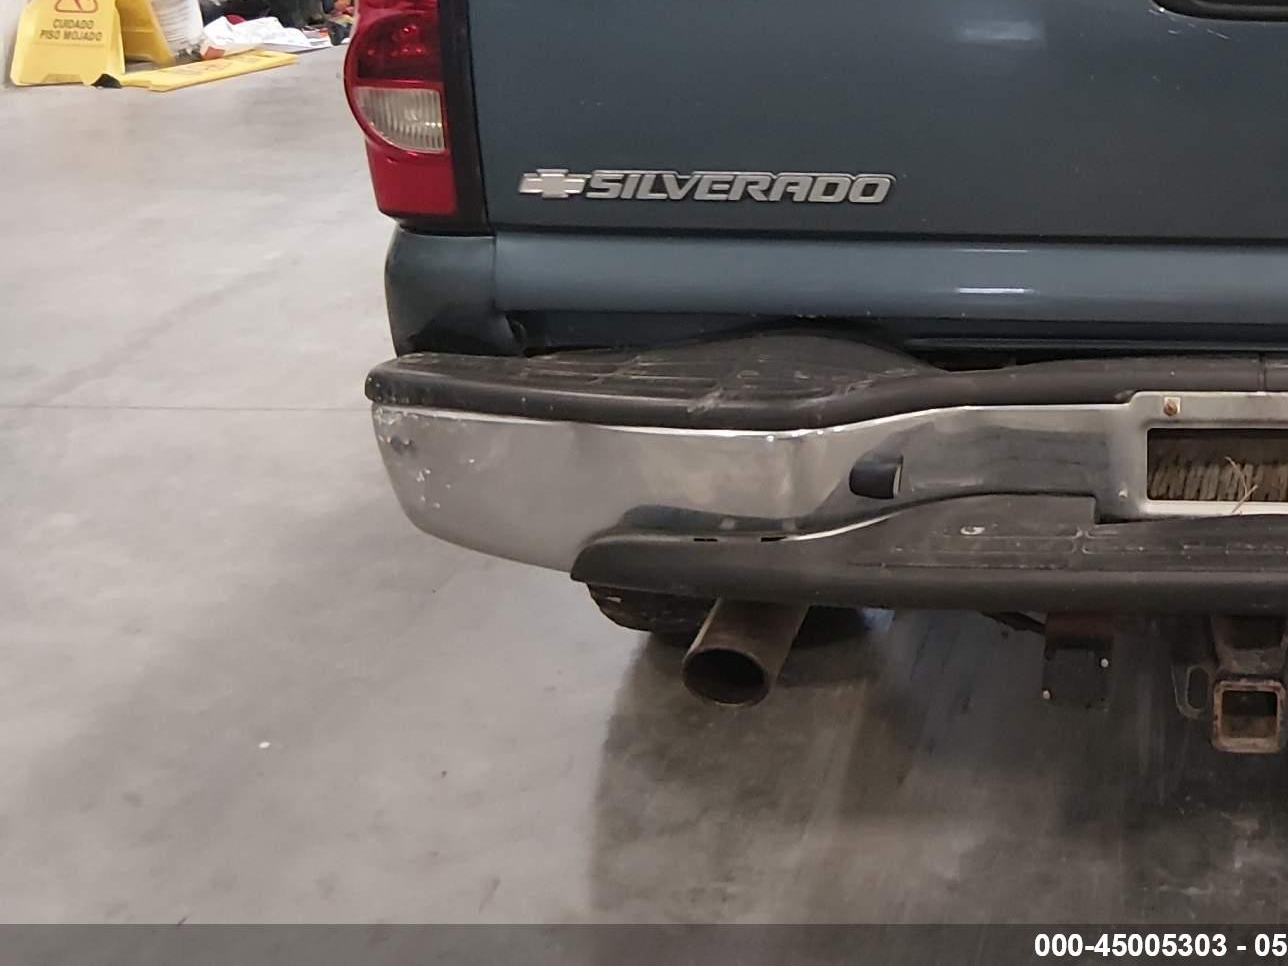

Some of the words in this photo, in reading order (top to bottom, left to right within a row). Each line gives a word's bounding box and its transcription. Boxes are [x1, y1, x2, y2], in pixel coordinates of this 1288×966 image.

[53, 19, 93, 29] CUIDADO
[40, 29, 61, 40] PISO
[63, 31, 102, 41] MOJADO
[585, 170, 897, 203] SILVERADO
